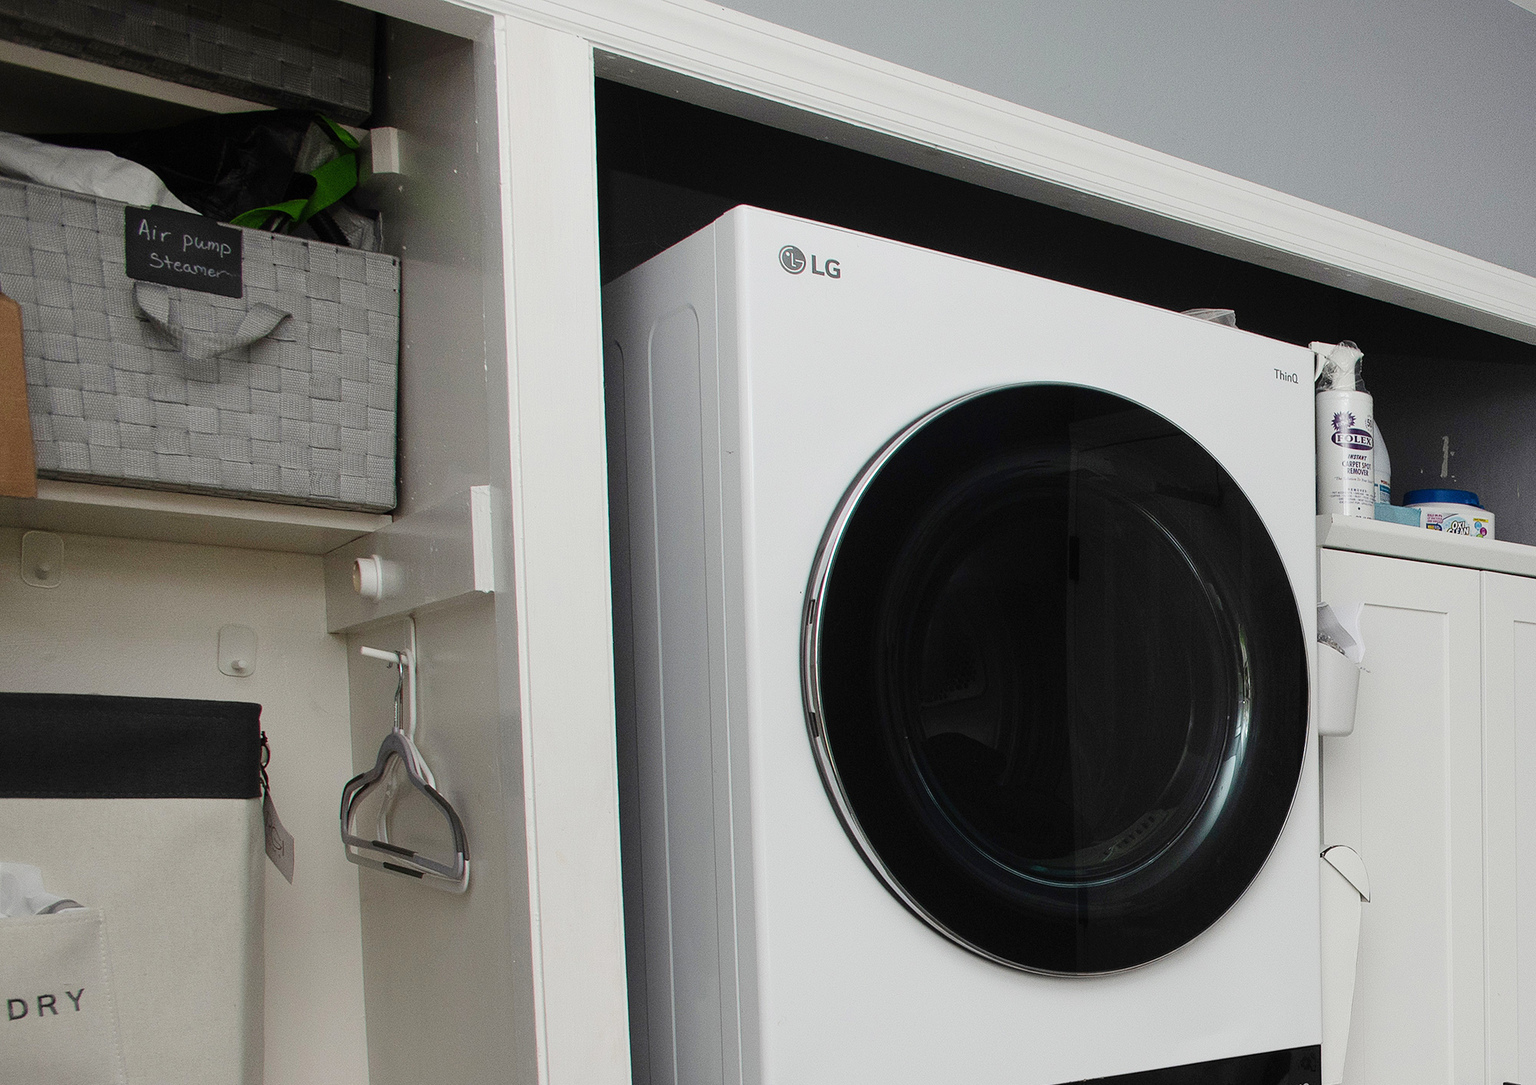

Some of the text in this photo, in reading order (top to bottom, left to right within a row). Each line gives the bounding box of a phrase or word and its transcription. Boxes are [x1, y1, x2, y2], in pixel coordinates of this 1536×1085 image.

[138, 218, 232, 258] Air pump
[149, 252, 234, 278] Steamer
[811, 253, 841, 279] LG
[1273, 367, 1299, 384] ThinQ
[1336, 434, 1373, 446] FOLEX
[1452, 520, 1466, 530] OXI
